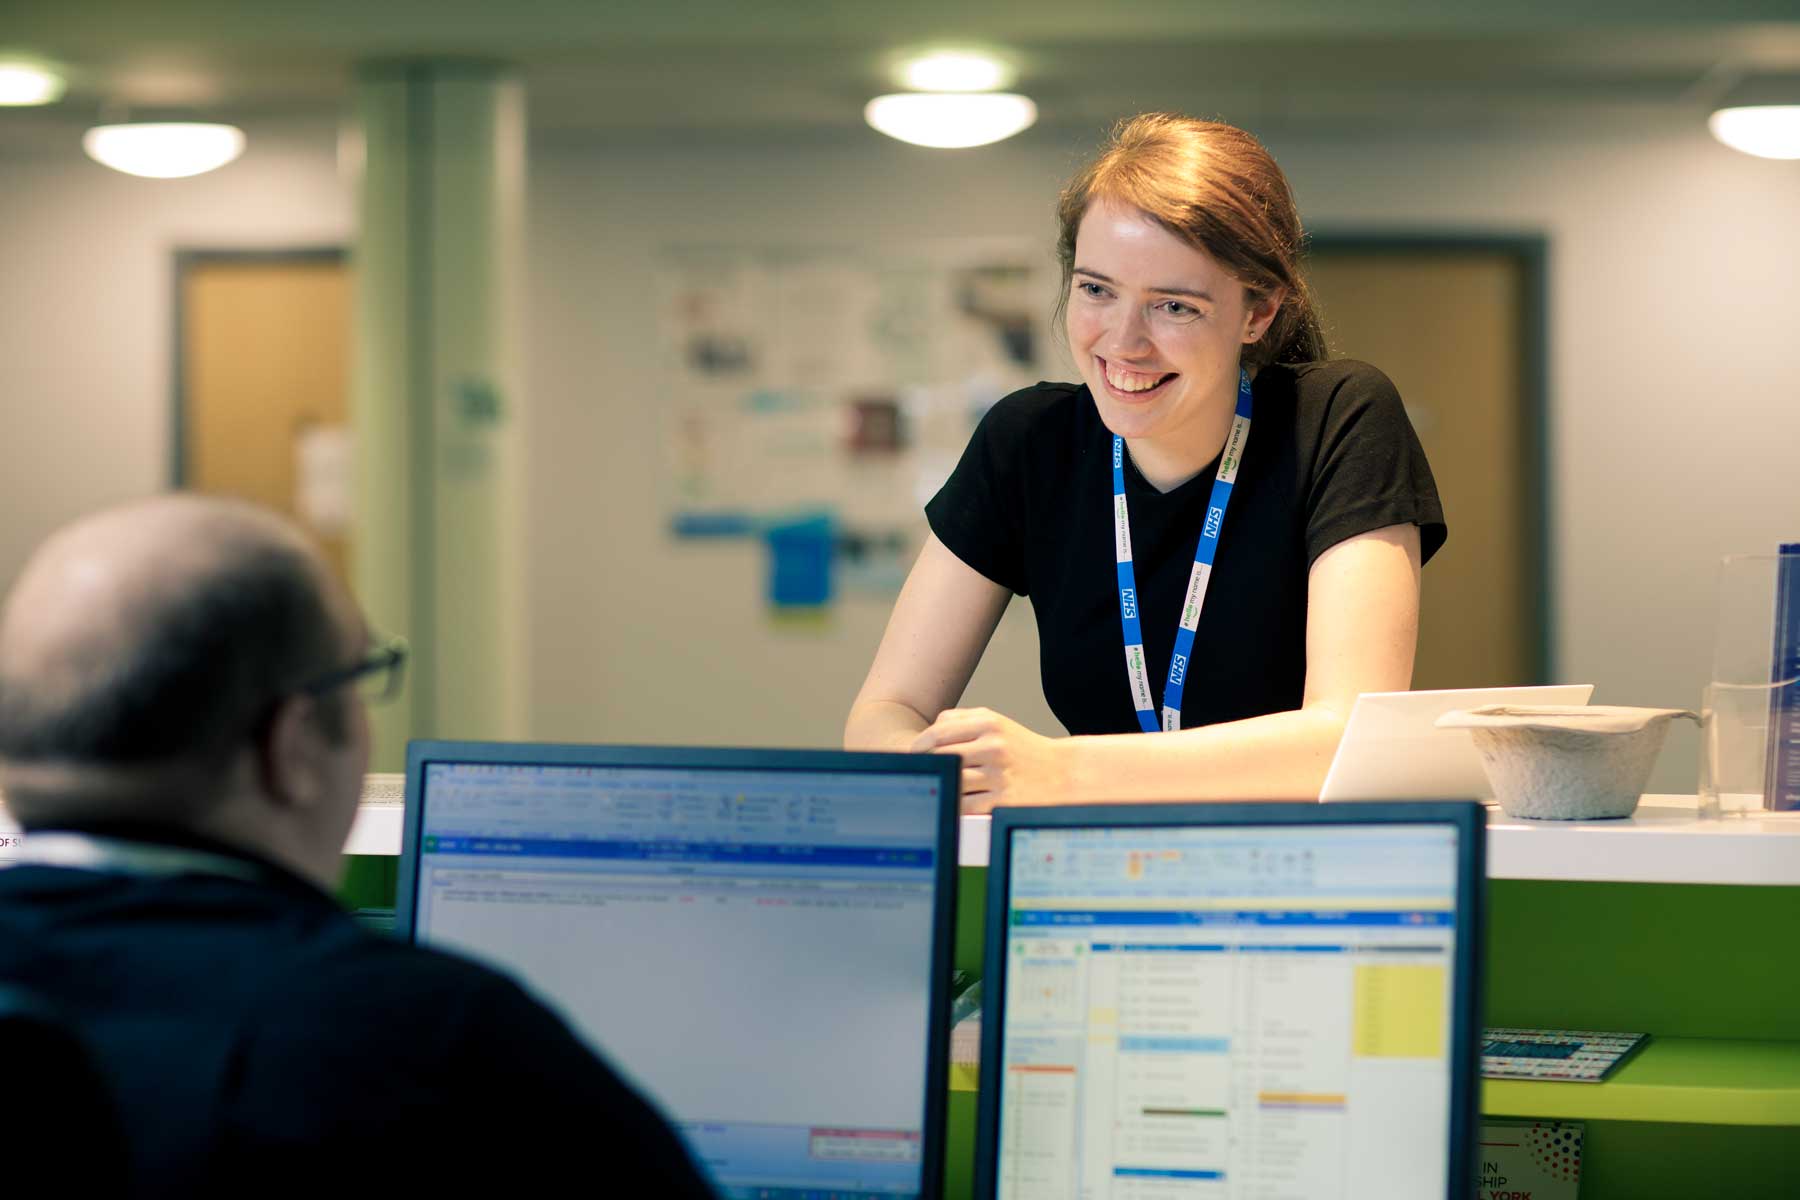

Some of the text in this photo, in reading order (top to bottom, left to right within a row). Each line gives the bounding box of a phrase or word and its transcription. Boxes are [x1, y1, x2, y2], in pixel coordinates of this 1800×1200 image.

[1232, 430, 1242, 446] name
[1114, 439, 1122, 468] NHS
[1230, 446, 1238, 457] my
[1204, 508, 1222, 538] NHS
[1191, 577, 1201, 593] name
[1122, 589, 1136, 618] NHS
[1189, 593, 1197, 604] my
[1137, 671, 1143, 682] my
[1170, 655, 1186, 685] NHS
[1483, 1161, 1498, 1174] IN
